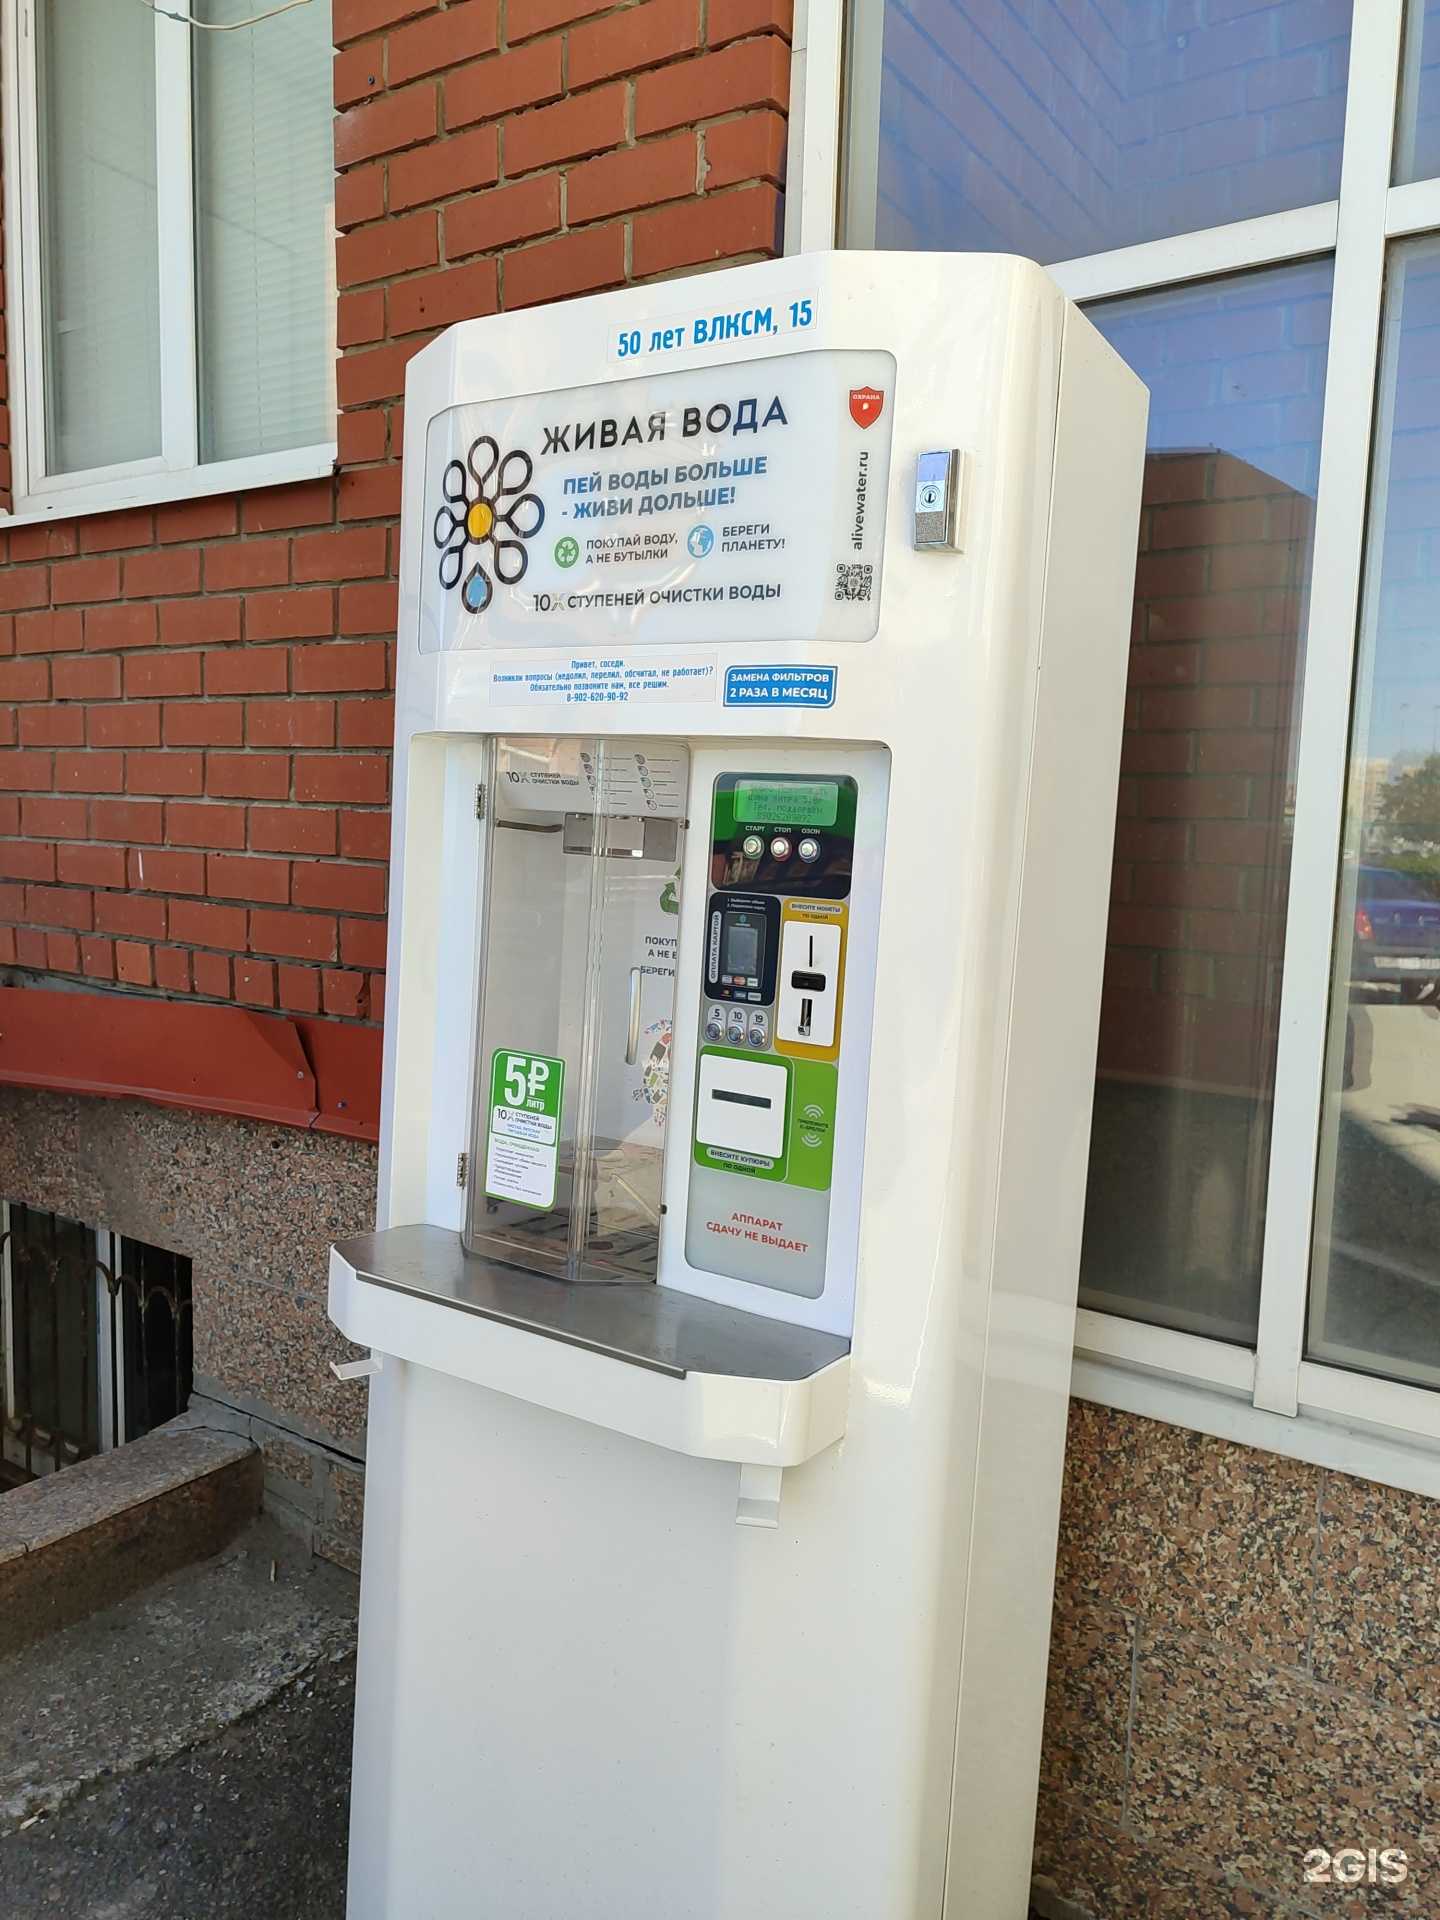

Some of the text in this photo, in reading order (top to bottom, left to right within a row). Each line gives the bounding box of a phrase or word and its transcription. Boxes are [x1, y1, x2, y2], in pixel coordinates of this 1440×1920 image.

[617, 299, 812, 357] 50 лет ВЛКСМ, 15
[852, 393, 881, 401] ОХРАНА
[540, 395, 788, 455] ЖИВАЯ ВОДА
[563, 456, 768, 495] ПЕЙ ВОДЫ БОЛЬШЕ
[573, 498, 633, 519] ЖИВИ
[638, 486, 736, 515] ДОЛЬШЕ!
[851, 451, 869, 551] alivewater.ru
[722, 523, 770, 537] БЕРЕГИ
[586, 532, 678, 550] ПОКУПАЙ ВОДУ,
[721, 538, 785, 553] ПЛАНЕТУ!
[586, 548, 668, 564] А НЕ БУТЫЛКИ
[567, 588, 645, 609] СТУПЕНЕЙ
[649, 586, 724, 604] ОЧИСТКИ
[728, 583, 781, 601] ВОДЫ
[525, 672, 553, 682] вопросы
[661, 667, 670, 676] не
[672, 665, 714, 677] работает)?
[731, 672, 830, 682] ЗАМЕНА ФИЛЬТРОВ
[530, 678, 669, 692] Обязательно позвоните нам, все решим.
[566, 691, 629, 702] 8-902-620-90-92
[729, 687, 828, 700] 2 РАЗА В МЕСЯЦ
[645, 935, 677, 947] ПОКУП
[648, 949, 655, 957] А
[657, 950, 670, 959] НЕ
[640, 965, 675, 977] БЕРЕГИ
[714, 1009, 720, 1017] 5
[734, 1012, 743, 1020] 10
[755, 1014, 763, 1023] 19
[731, 1212, 783, 1231] АППАРАТ
[706, 1221, 809, 1253] СДАЧУ НЕ ВЫДАЕТ
